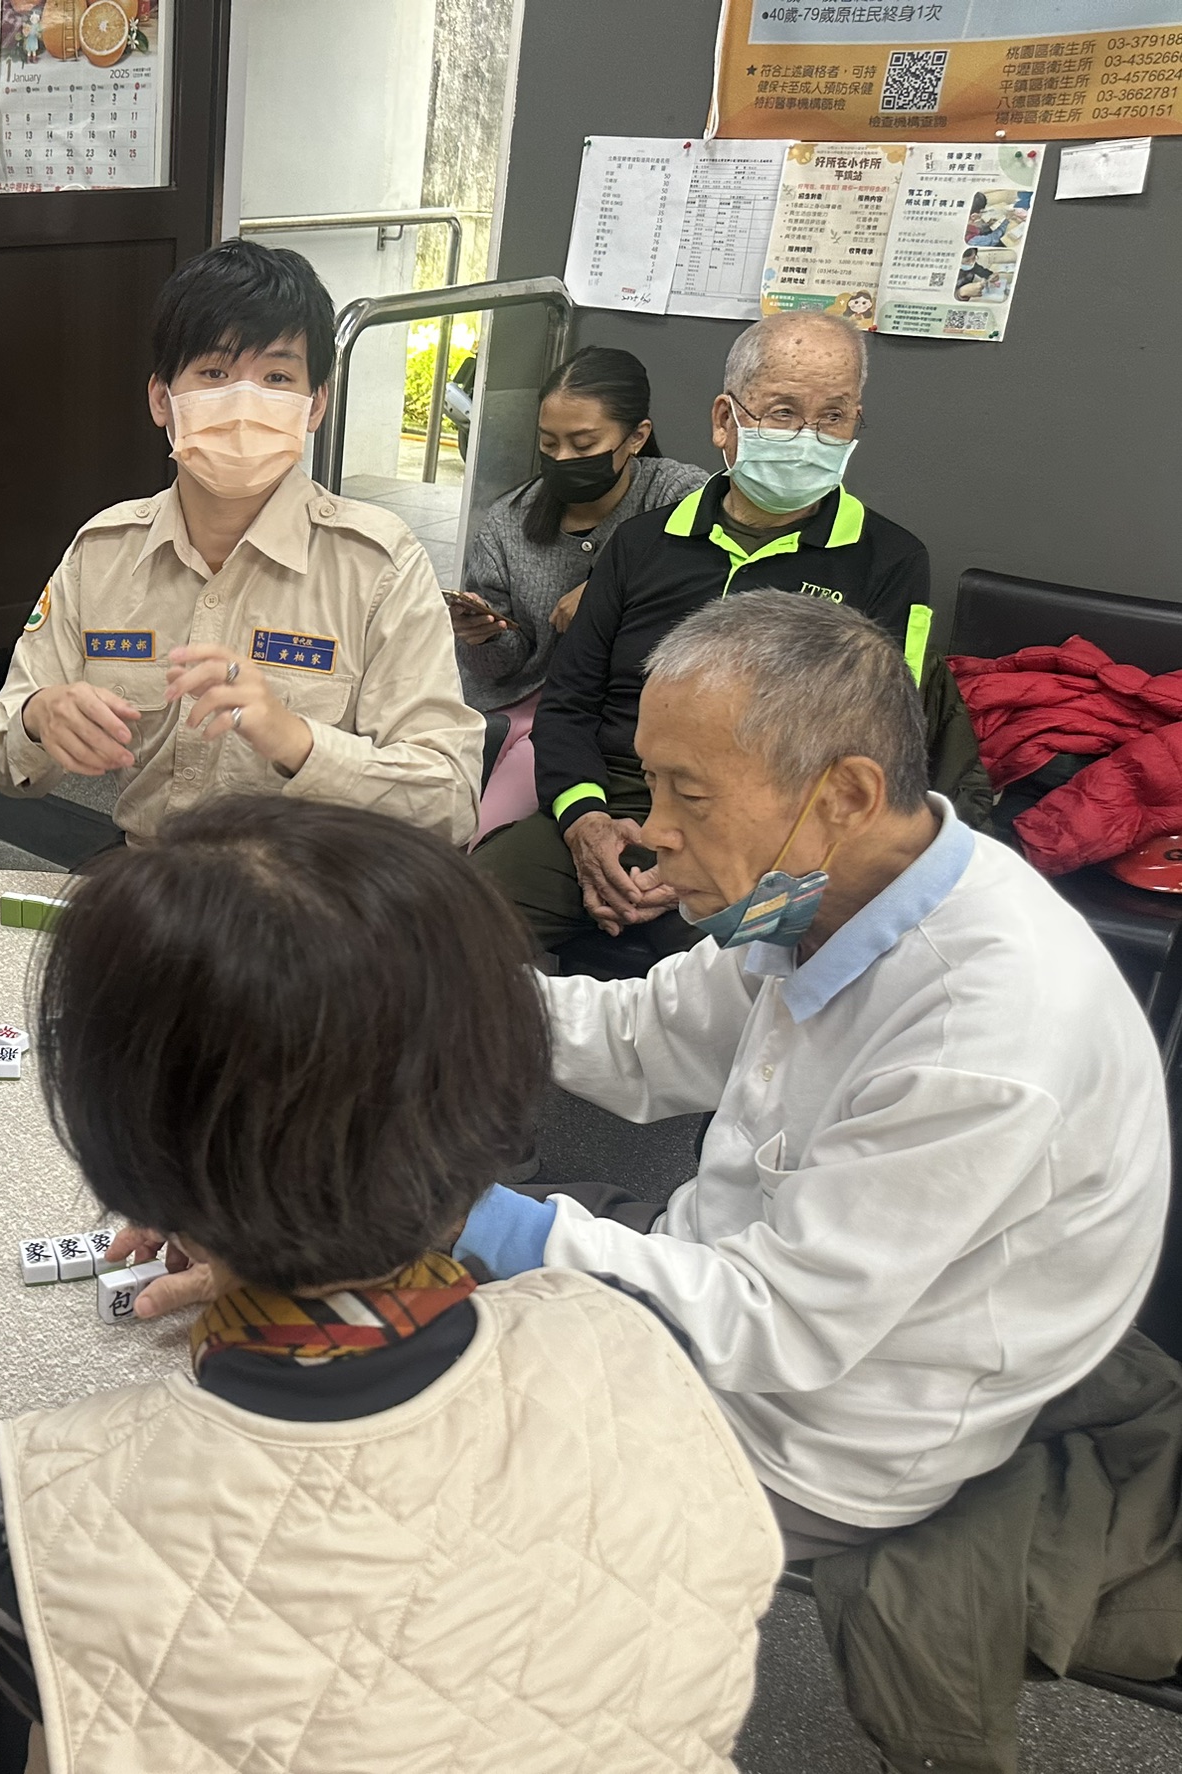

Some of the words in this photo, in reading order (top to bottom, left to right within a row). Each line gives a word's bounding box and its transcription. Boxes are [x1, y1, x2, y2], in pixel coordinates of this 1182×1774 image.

[1006, 39, 1097, 60] 桃園區衛生所
[12, 73, 41, 84] January
[110, 69, 130, 79] 2025
[999, 74, 1090, 93] 平鎮區衛生所
[996, 91, 1087, 110] 八德區衛生所
[1096, 86, 1178, 103] 03-3662781
[1092, 104, 1173, 120] 03-4750151
[815, 157, 882, 169] 好所在小作所
[91, 638, 147, 651] 管理幹部
[25, 1242, 53, 1263] 象
[58, 1239, 87, 1258] 象
[109, 1291, 135, 1318] 包
